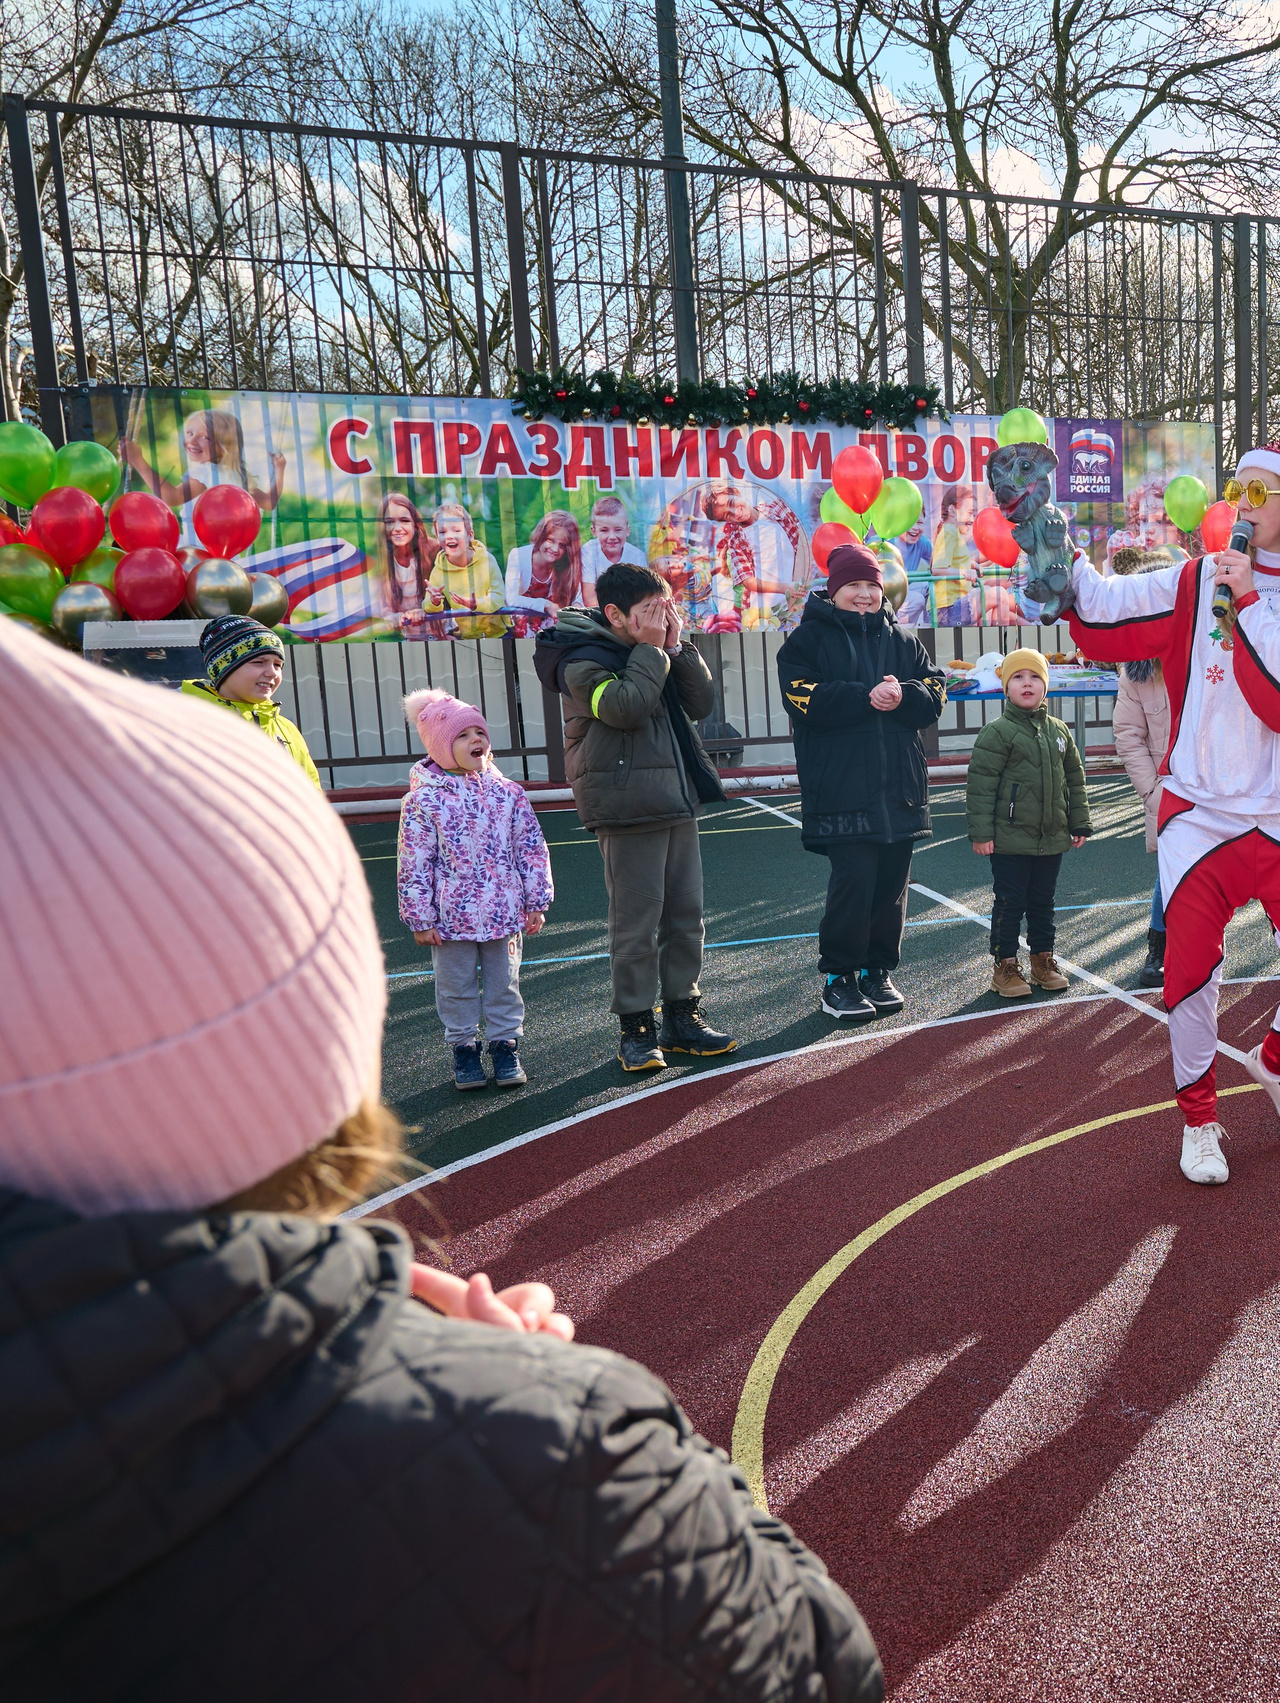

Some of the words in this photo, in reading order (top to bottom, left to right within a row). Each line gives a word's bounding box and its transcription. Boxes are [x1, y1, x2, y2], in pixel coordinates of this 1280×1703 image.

[329, 418, 374, 475] С
[394, 419, 832, 489] ПРАЗДНИКОМ
[859, 432, 1049, 483] ДВОР
[1070, 475, 1110, 484] ЕДИНАЯ
[1070, 485, 1110, 493] РОССИЯ
